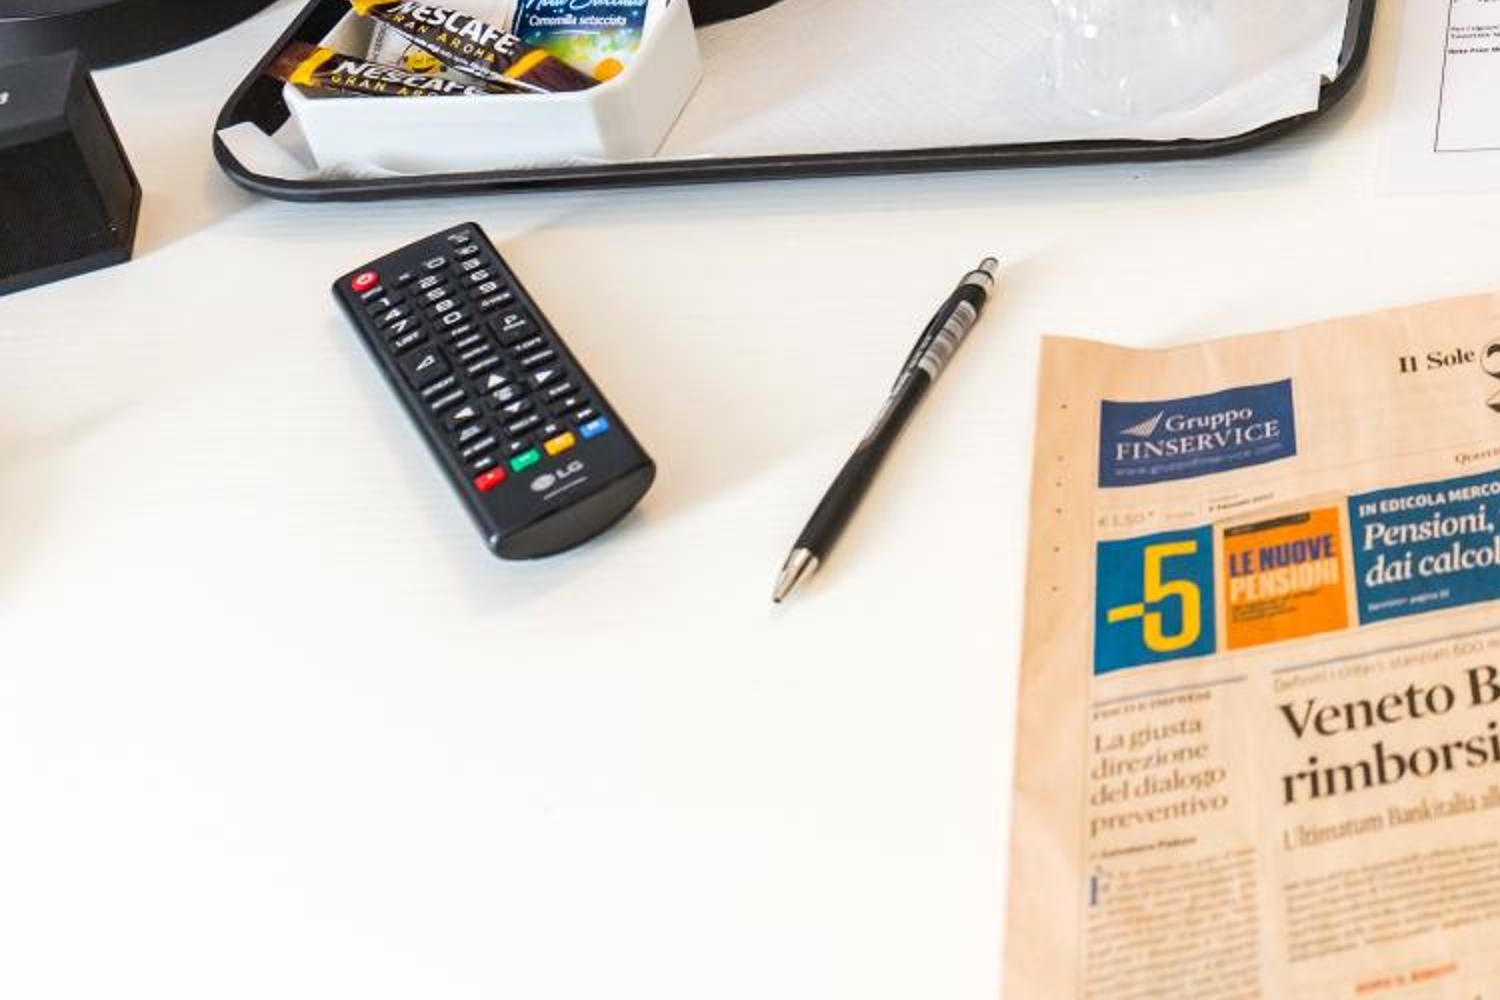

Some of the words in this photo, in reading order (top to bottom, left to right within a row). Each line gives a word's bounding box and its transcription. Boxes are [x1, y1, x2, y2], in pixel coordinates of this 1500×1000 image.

[437, 33, 496, 62] AROMA
[331, 74, 387, 91] GRAN
[1398, 354, 1420, 374] Il
[1427, 346, 1475, 372] Sole
[1165, 408, 1253, 433] Gruppo
[1115, 419, 1281, 461] FINSERVICE
[556, 460, 584, 479] LG
[1360, 502, 1377, 517] IN
[1380, 493, 1447, 514] EDICOLA
[1363, 505, 1495, 551] Pensioni,
[1230, 550, 1255, 577] LE
[1259, 534, 1335, 571] NUOVE
[1365, 553, 1412, 587] dai
[1107, 540, 1200, 653] -5
[1229, 559, 1339, 602] PENSIONI
[1279, 682, 1455, 739] Veneto
[1095, 735, 1124, 752] La
[1129, 719, 1203, 750] giusta
[1091, 742, 1210, 780] direzione
[1091, 780, 1129, 806] del
[1134, 767, 1227, 797] dialogo
[1090, 795, 1229, 838] preventivo
[1283, 814, 1383, 850] Ultimatum
[1388, 791, 1477, 827] Bankitalia
